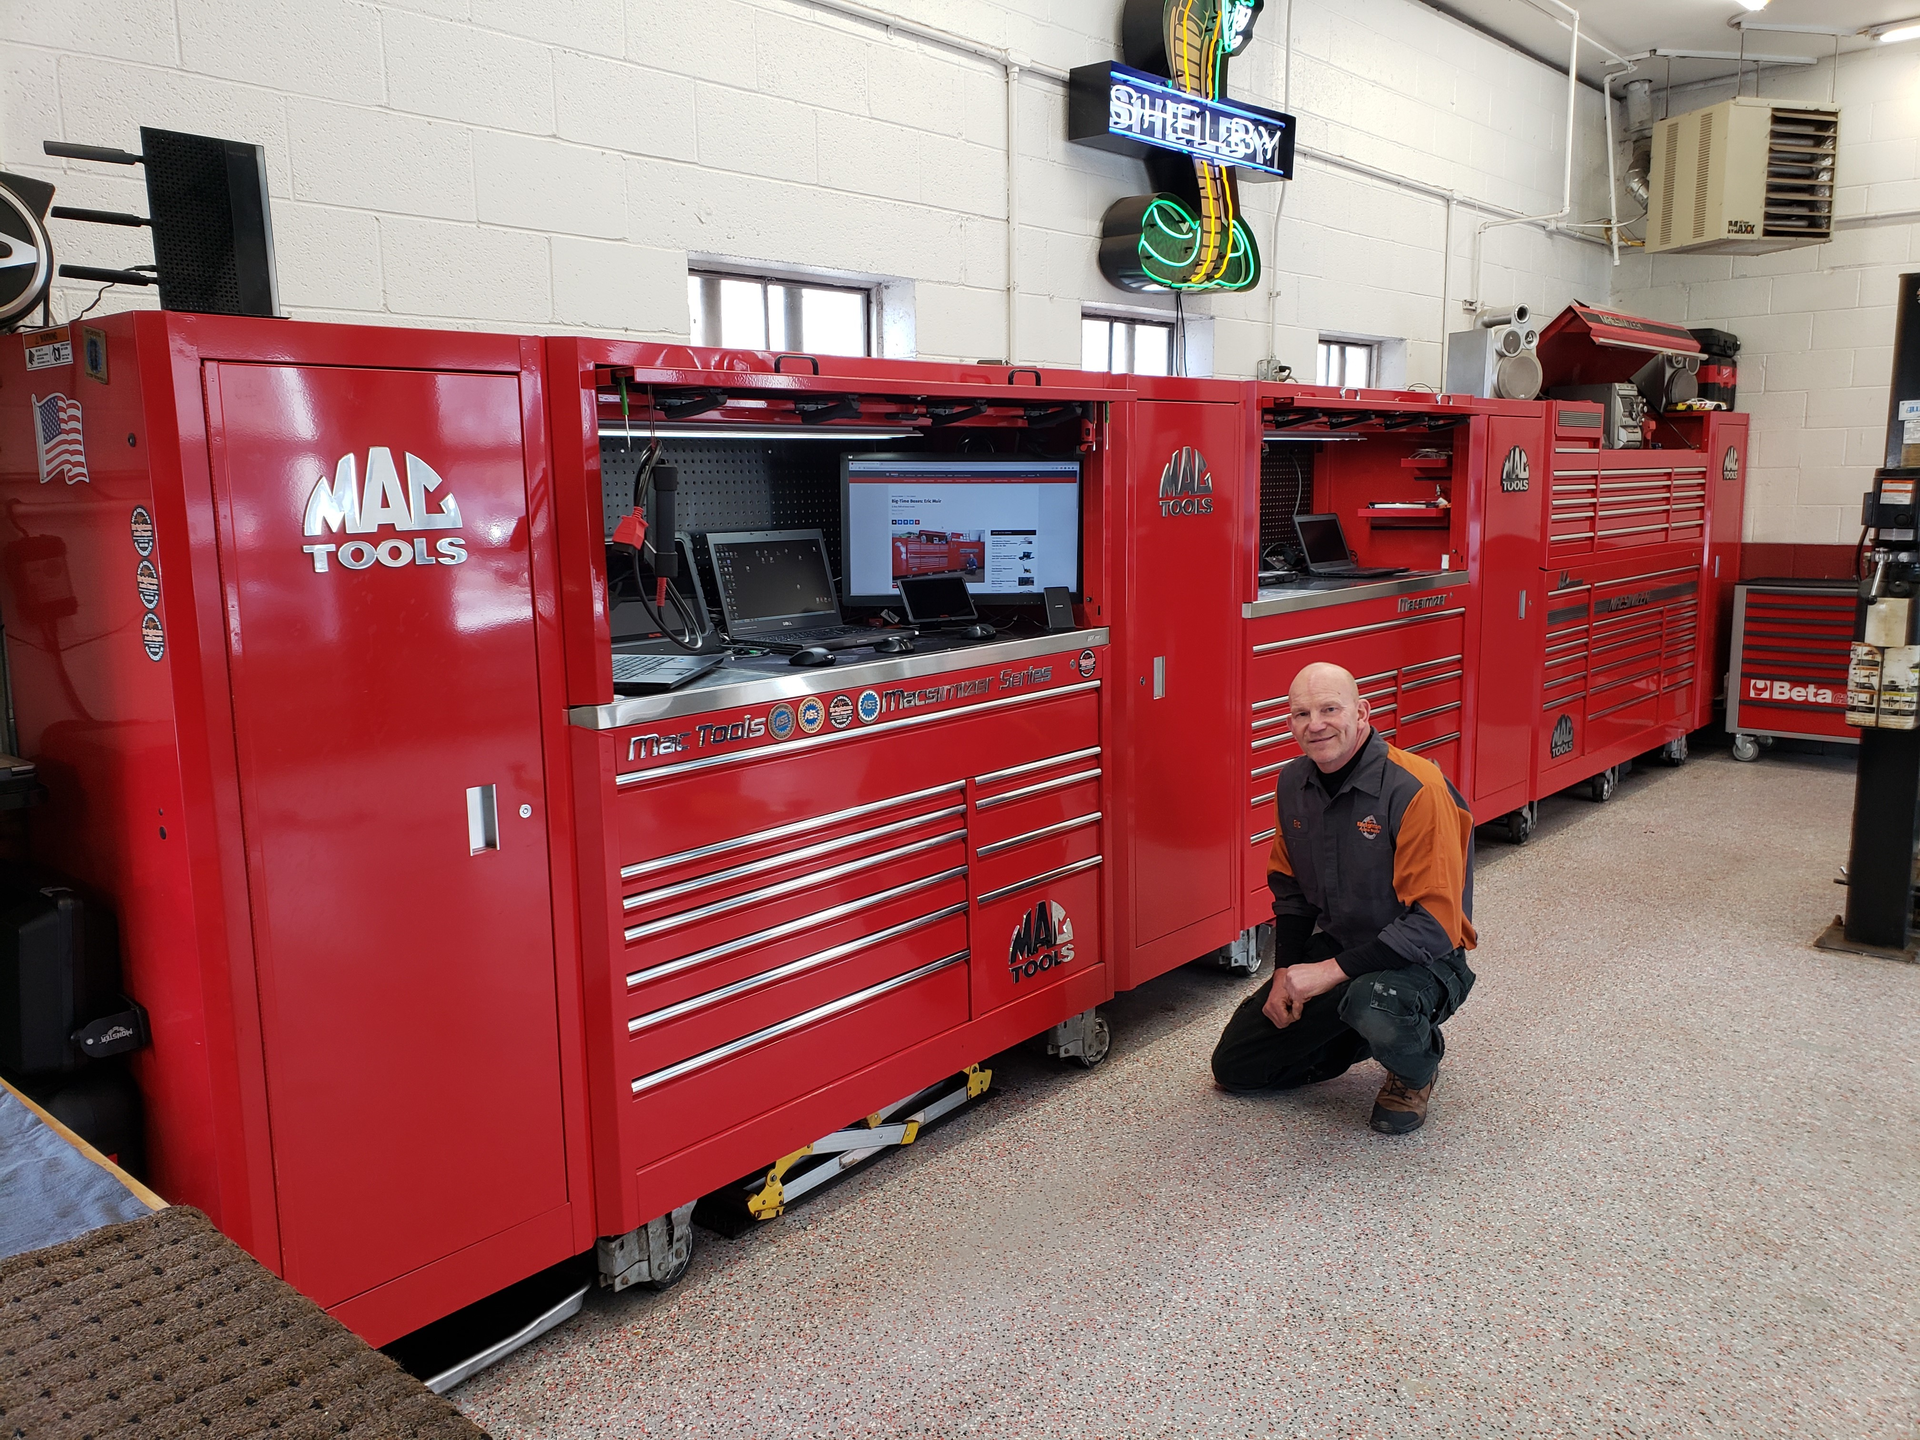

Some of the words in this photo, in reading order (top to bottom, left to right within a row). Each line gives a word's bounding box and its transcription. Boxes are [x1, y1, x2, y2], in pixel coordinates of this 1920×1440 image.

[1109, 85, 1281, 164] SHELBY
[1159, 446, 1213, 498] MAC
[1502, 446, 1529, 479] MAC
[304, 446, 463, 536] MAC
[1503, 480, 1528, 490] TOOLS
[1159, 497, 1213, 517] TOOLS
[302, 537, 468, 572] TOOLS
[862, 700, 876, 710] ASE
[1772, 681, 1833, 703] Beta
[628, 733, 692, 761] Mac
[695, 714, 767, 748] Tools
[881, 677, 995, 713] Macsimizer
[999, 665, 1053, 690] Series
[776, 714, 790, 727] ASE
[804, 709, 818, 720] ASE
[1551, 715, 1573, 748] MAC
[1552, 741, 1573, 758] TOOLS
[1008, 900, 1074, 965] MAC
[1009, 944, 1075, 984] TOOLS
